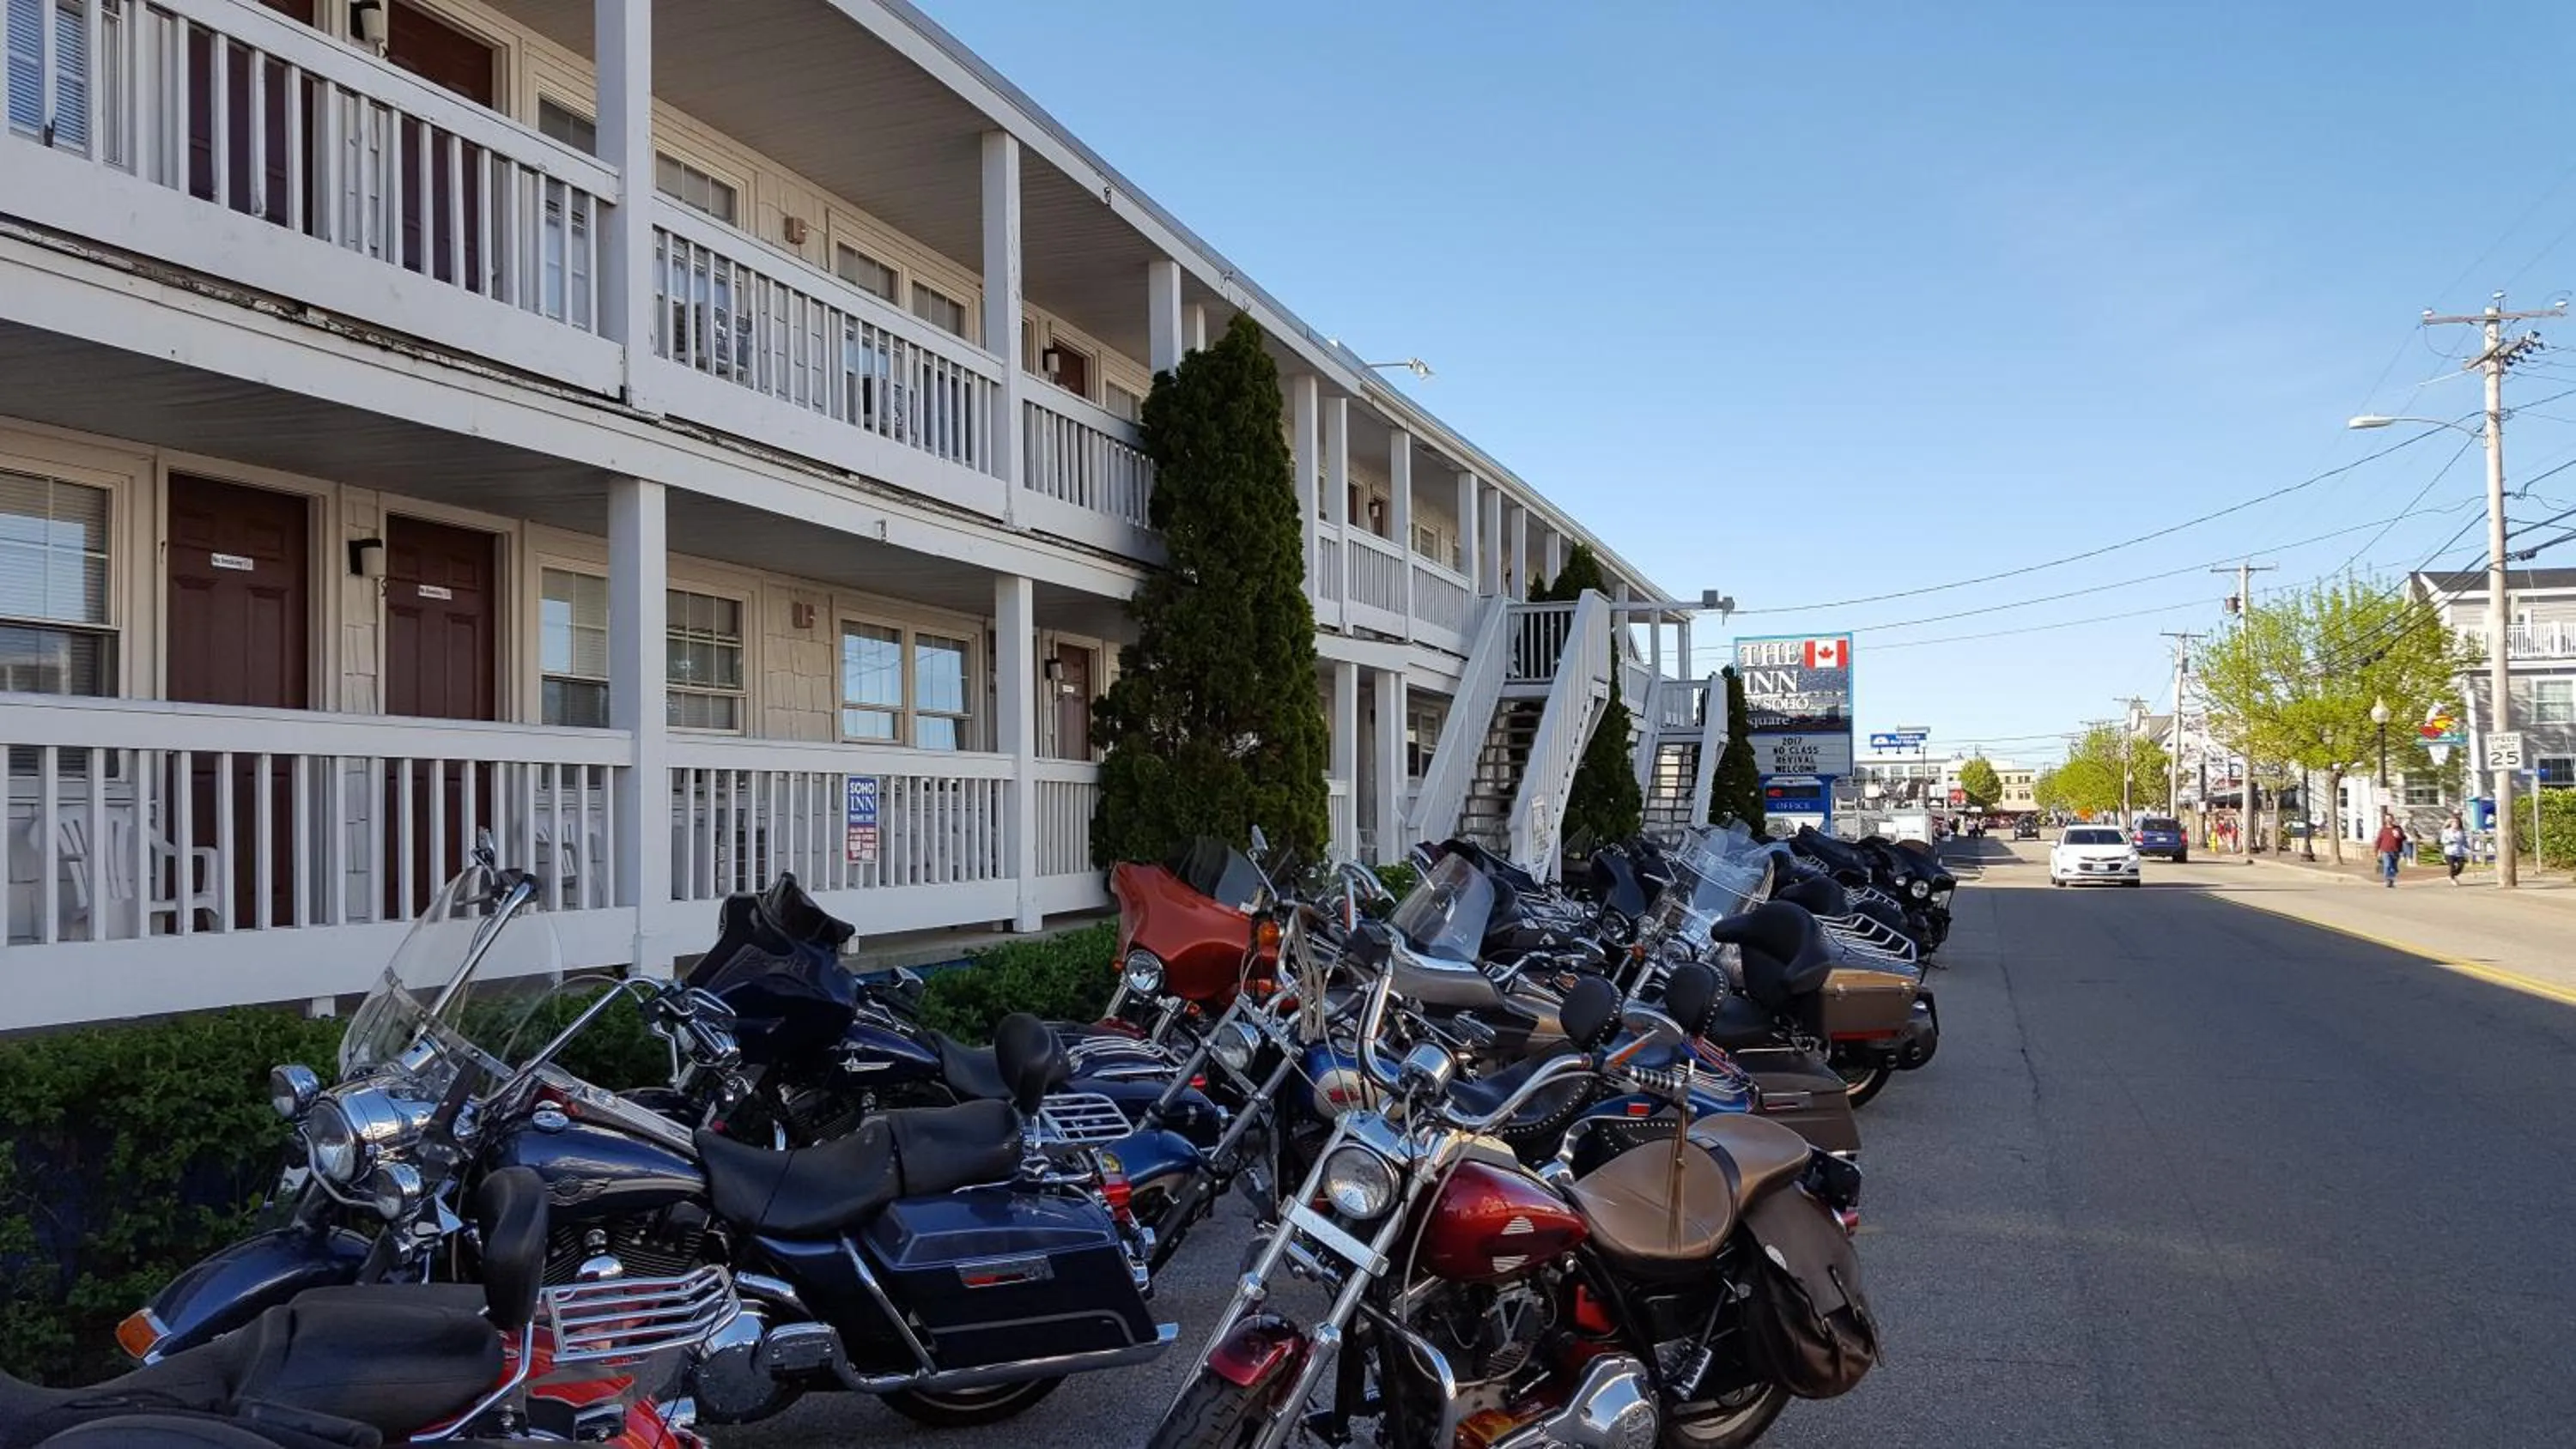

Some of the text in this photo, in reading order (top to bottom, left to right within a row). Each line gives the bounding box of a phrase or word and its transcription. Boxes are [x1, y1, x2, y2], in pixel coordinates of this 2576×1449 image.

[1741, 643, 1801, 666] THE
[1743, 670, 1798, 694] INN
[1747, 716, 1790, 728] quare
[1783, 737, 1802, 746] 2017
[1789, 746, 1819, 755] CLASS
[2490, 752, 2519, 766] 25
[849, 782, 875, 794] SOHO
[850, 796, 875, 811] INN
